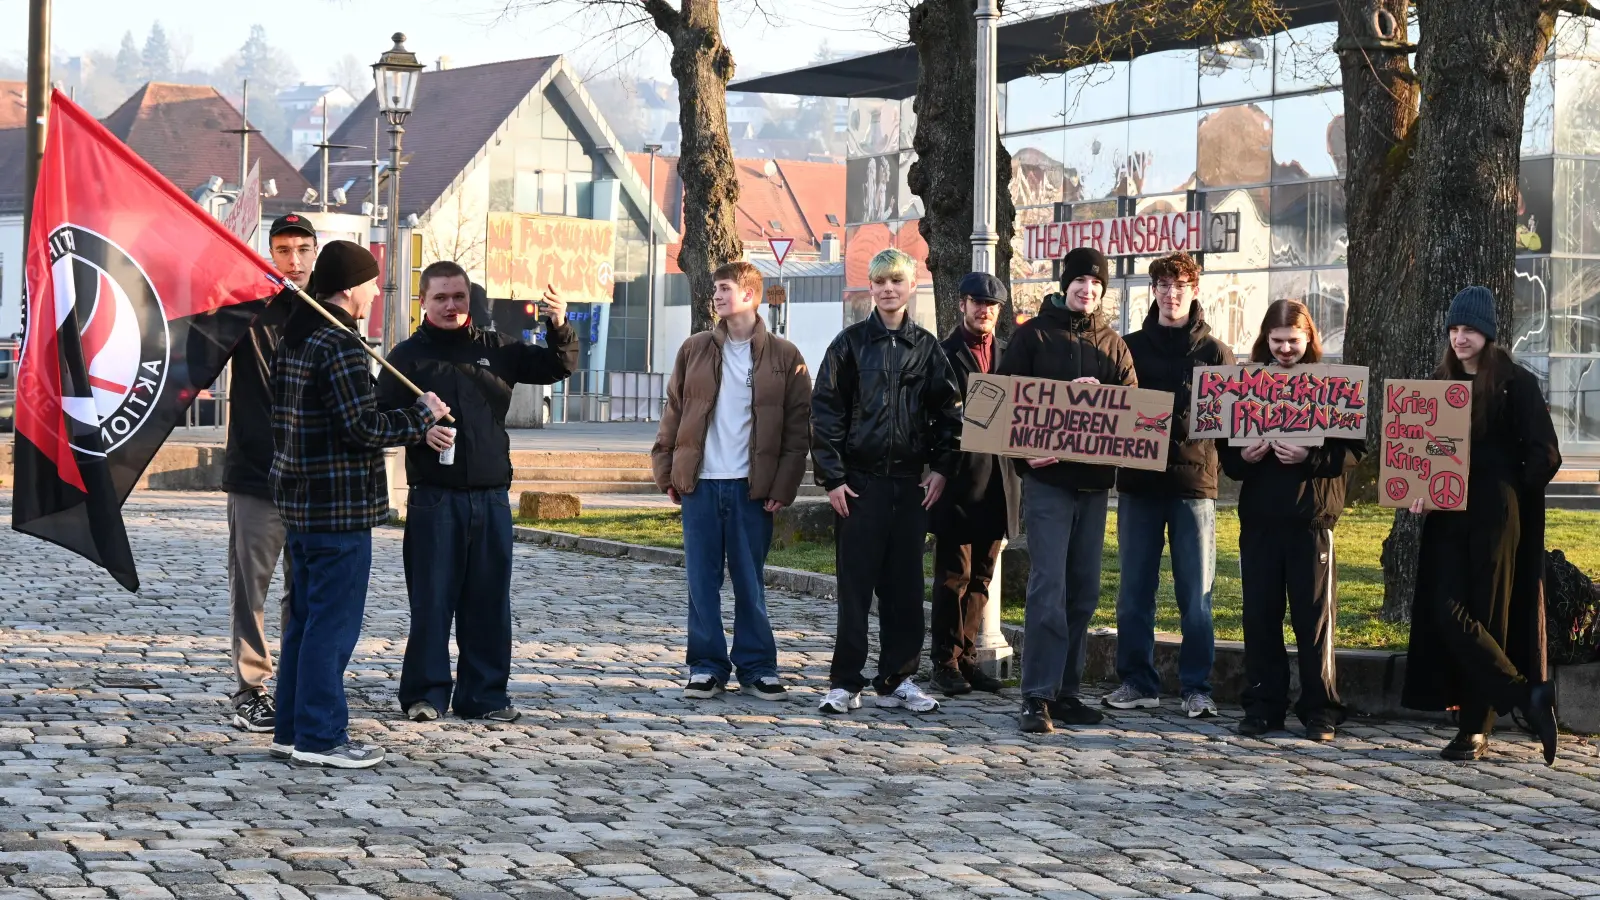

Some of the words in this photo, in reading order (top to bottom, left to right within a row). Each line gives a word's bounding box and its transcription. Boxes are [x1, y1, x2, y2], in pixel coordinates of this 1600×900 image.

[1025, 220, 1105, 259] THEATER
[1107, 211, 1200, 255] ANSBACH
[1014, 381, 1056, 405] ICH
[1065, 384, 1132, 411] WILL
[1386, 384, 1438, 426] Krieg
[1011, 404, 1119, 436] STUDIEREN
[1231, 399, 1330, 438] FRIEDEN
[1385, 415, 1424, 439] dem
[1009, 426, 1054, 450] NICHT
[1052, 431, 1161, 460] SALUTIEREN
[1386, 441, 1431, 480] Krieg
